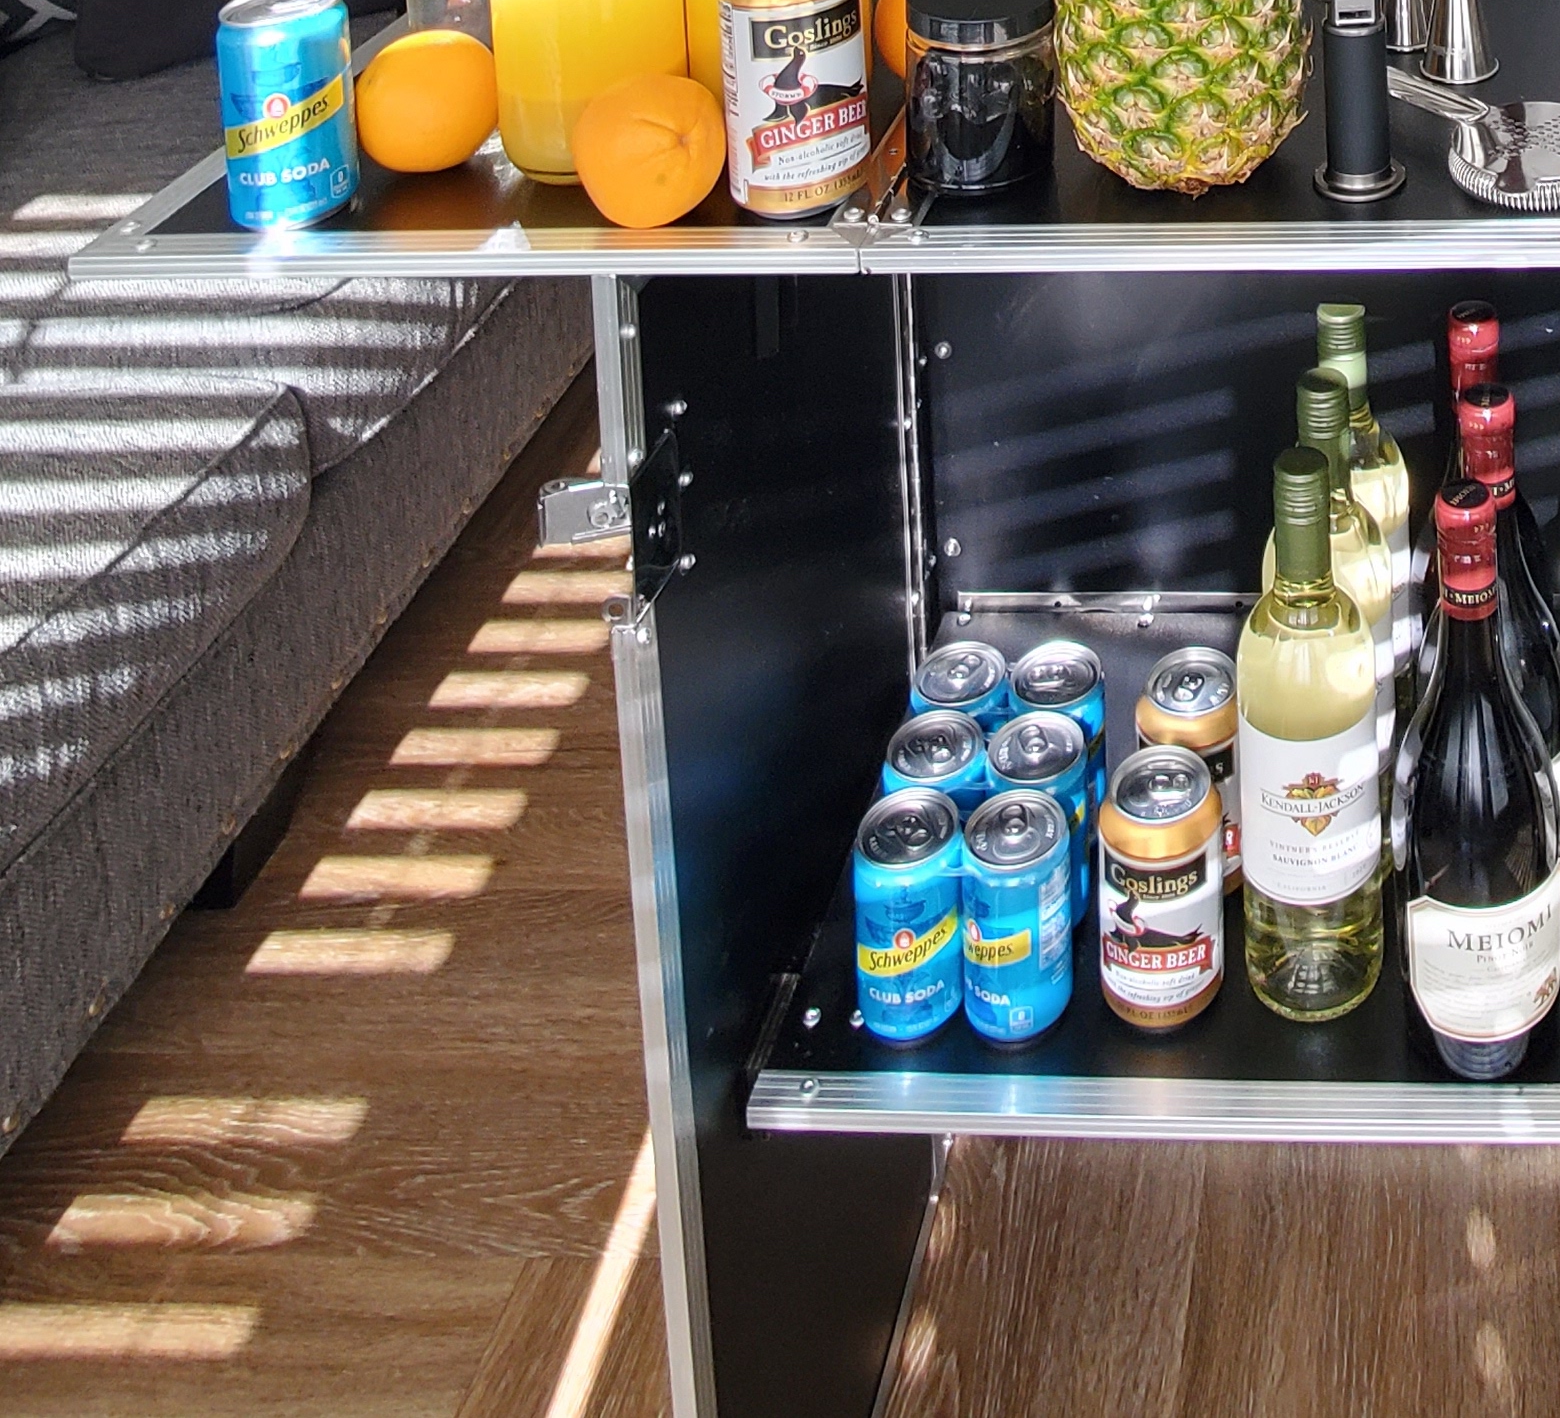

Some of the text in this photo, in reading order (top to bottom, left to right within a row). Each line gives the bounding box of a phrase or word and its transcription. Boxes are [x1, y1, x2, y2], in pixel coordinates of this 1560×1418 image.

[764, 10, 857, 49] Goslings
[238, 95, 329, 154] Schweppes
[761, 101, 867, 149] GINGER BEER
[240, 158, 330, 187] CLUB SODA
[765, 171, 780, 181] with
[782, 170, 795, 180] the
[784, 185, 829, 202] 12 FL OZ
[1261, 783, 1364, 814] KENDALL-JACKSON
[1273, 845, 1357, 867] SAUVIGNON BLANC
[1111, 864, 1198, 894] Goslings
[1447, 903, 1552, 951] MEIOMI
[870, 923, 947, 970] Schweppes
[1106, 941, 1206, 969] GINGER BEER
[870, 980, 944, 1004] CLUB SODA
[975, 985, 1010, 1006] SODA
